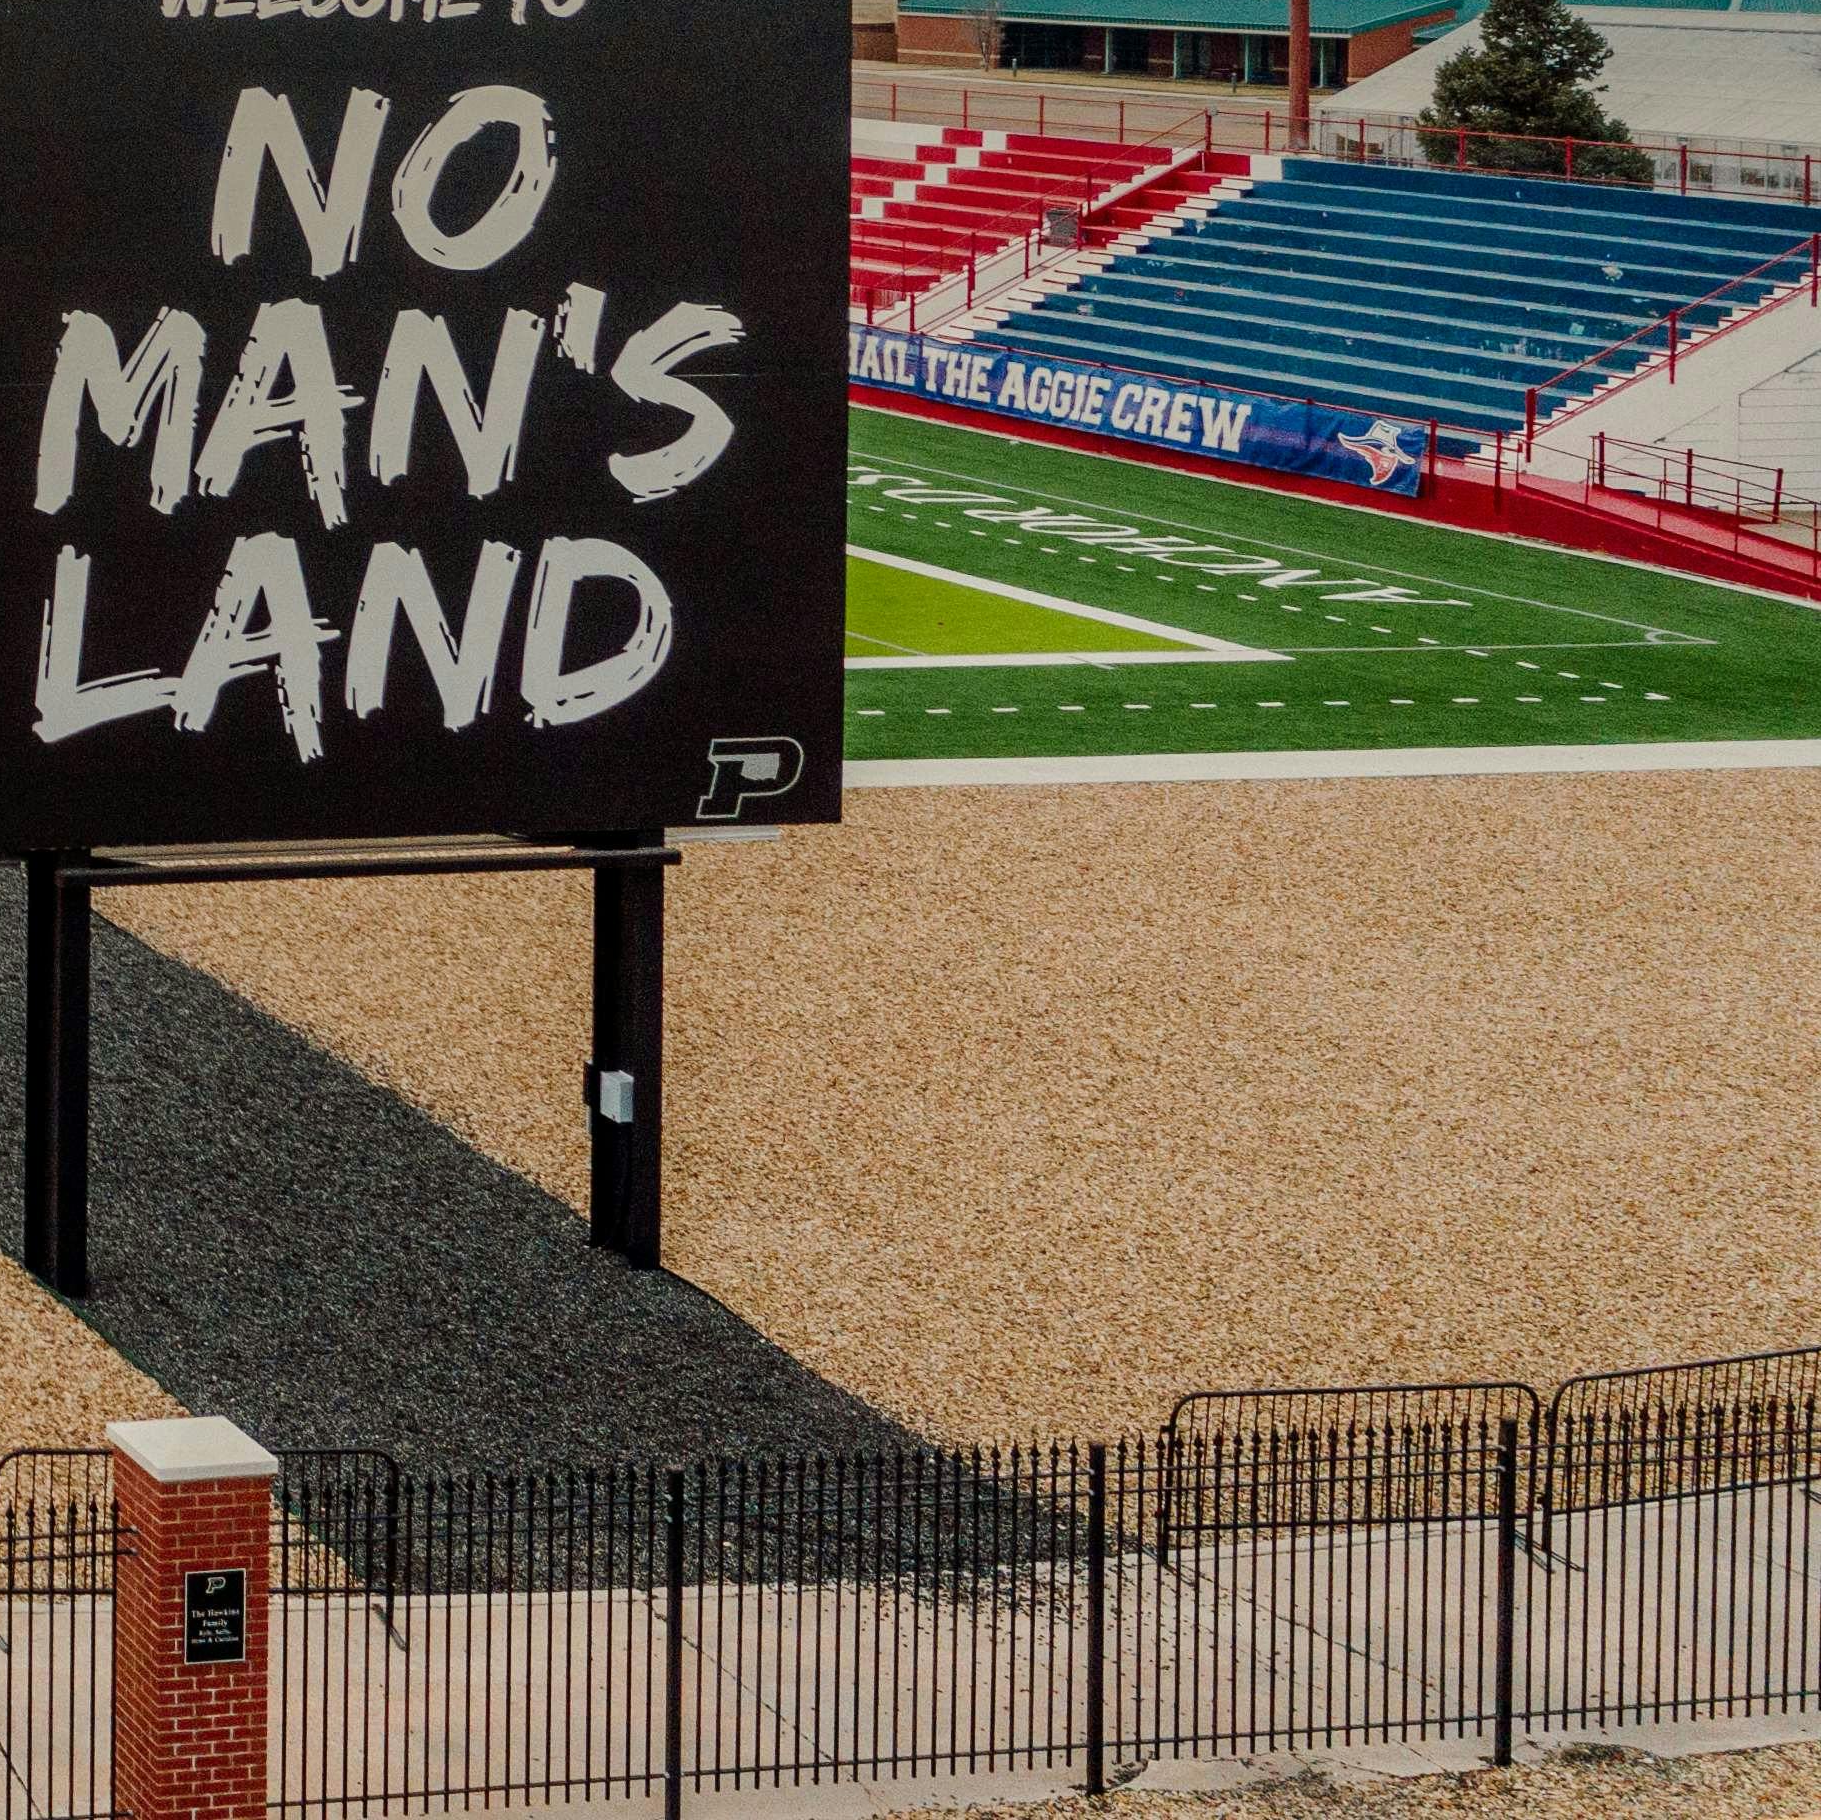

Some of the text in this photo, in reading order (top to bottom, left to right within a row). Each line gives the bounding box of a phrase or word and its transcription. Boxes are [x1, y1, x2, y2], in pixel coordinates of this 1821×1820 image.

[211, 85, 559, 279] NO
[34, 282, 745, 529] MAN'S
[921, 345, 996, 404] THE
[997, 362, 1113, 426] AGGIE
[1111, 382, 1253, 453] CREW
[32, 531, 672, 763] LAND
[696, 737, 804, 819] P
[205, 1576, 227, 1594] P
